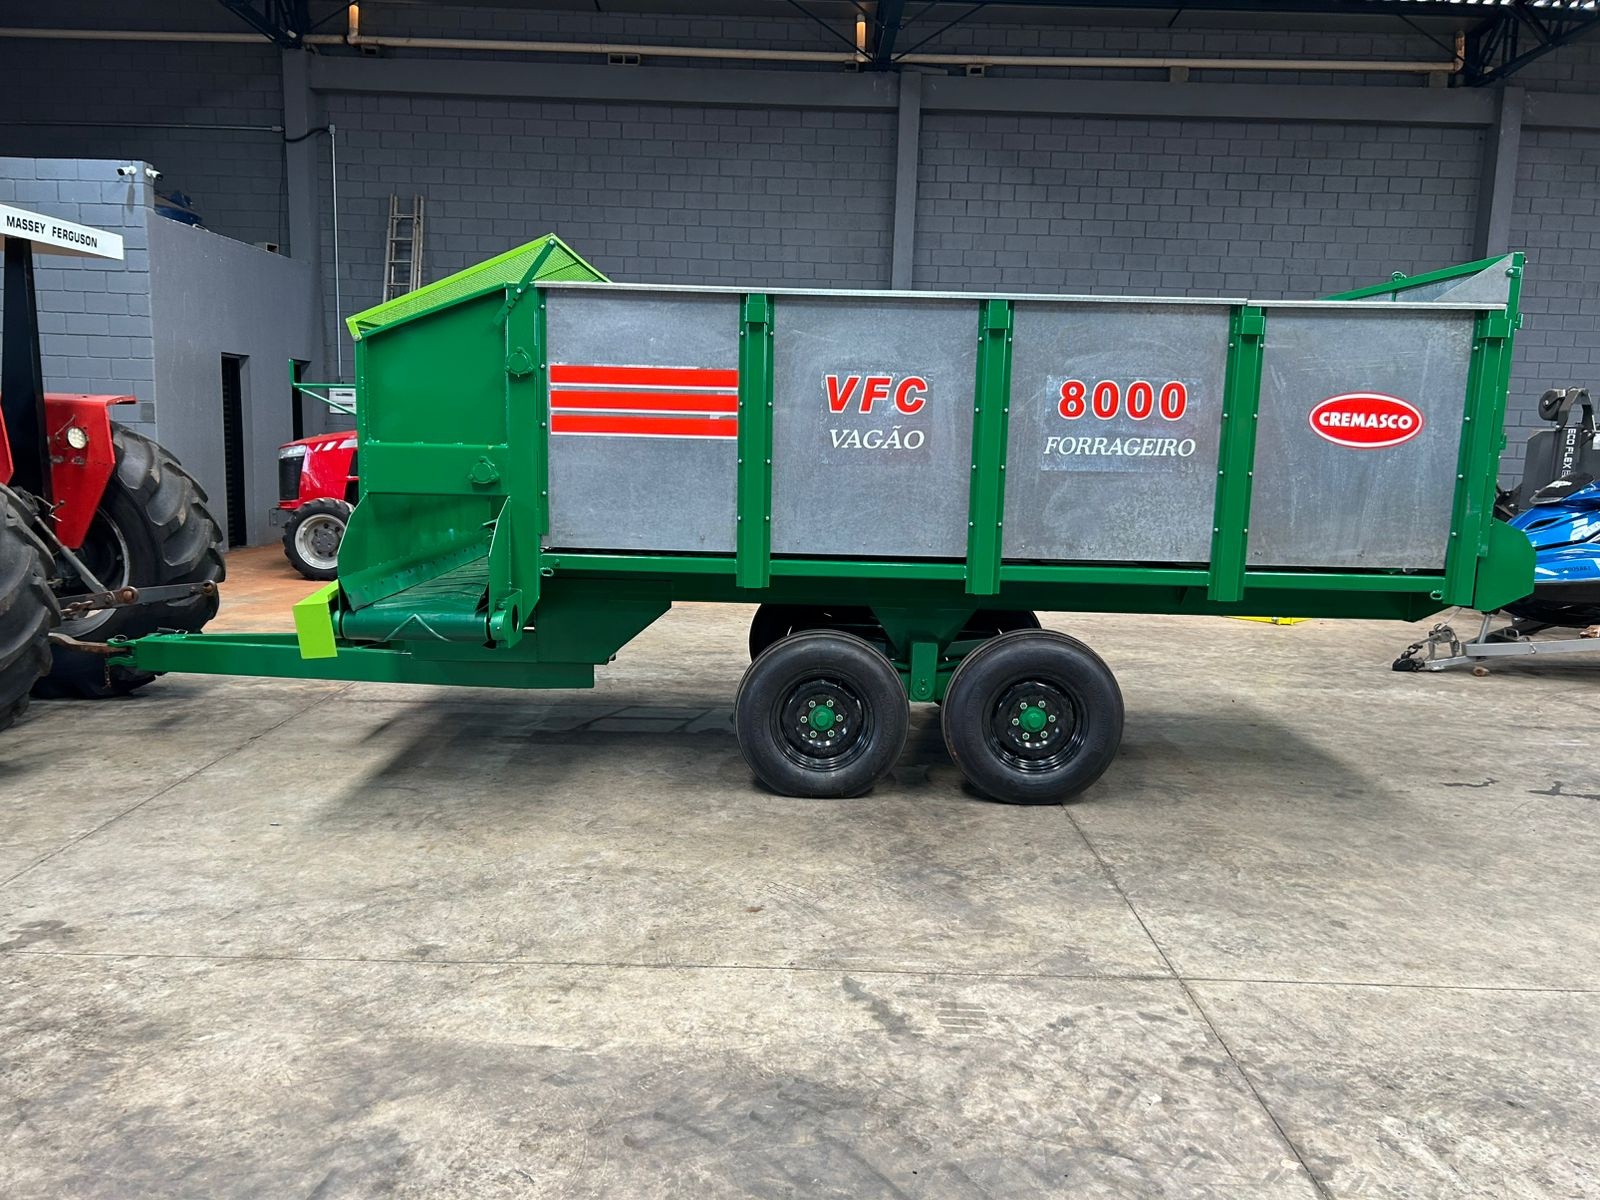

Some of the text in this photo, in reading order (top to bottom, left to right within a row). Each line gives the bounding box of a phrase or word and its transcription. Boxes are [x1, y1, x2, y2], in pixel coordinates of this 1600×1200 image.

[6, 215, 98, 248] MASSEY FERGUSON
[825, 374, 928, 415] VFC
[1057, 379, 1188, 421] 8000
[1318, 411, 1413, 430] CREMASCO
[829, 425, 925, 450] VAGÃO
[1043, 436, 1196, 457] FORRAGEIRO
[1566, 428, 1577, 445] ECO
[1562, 446, 1574, 469] FLEX
